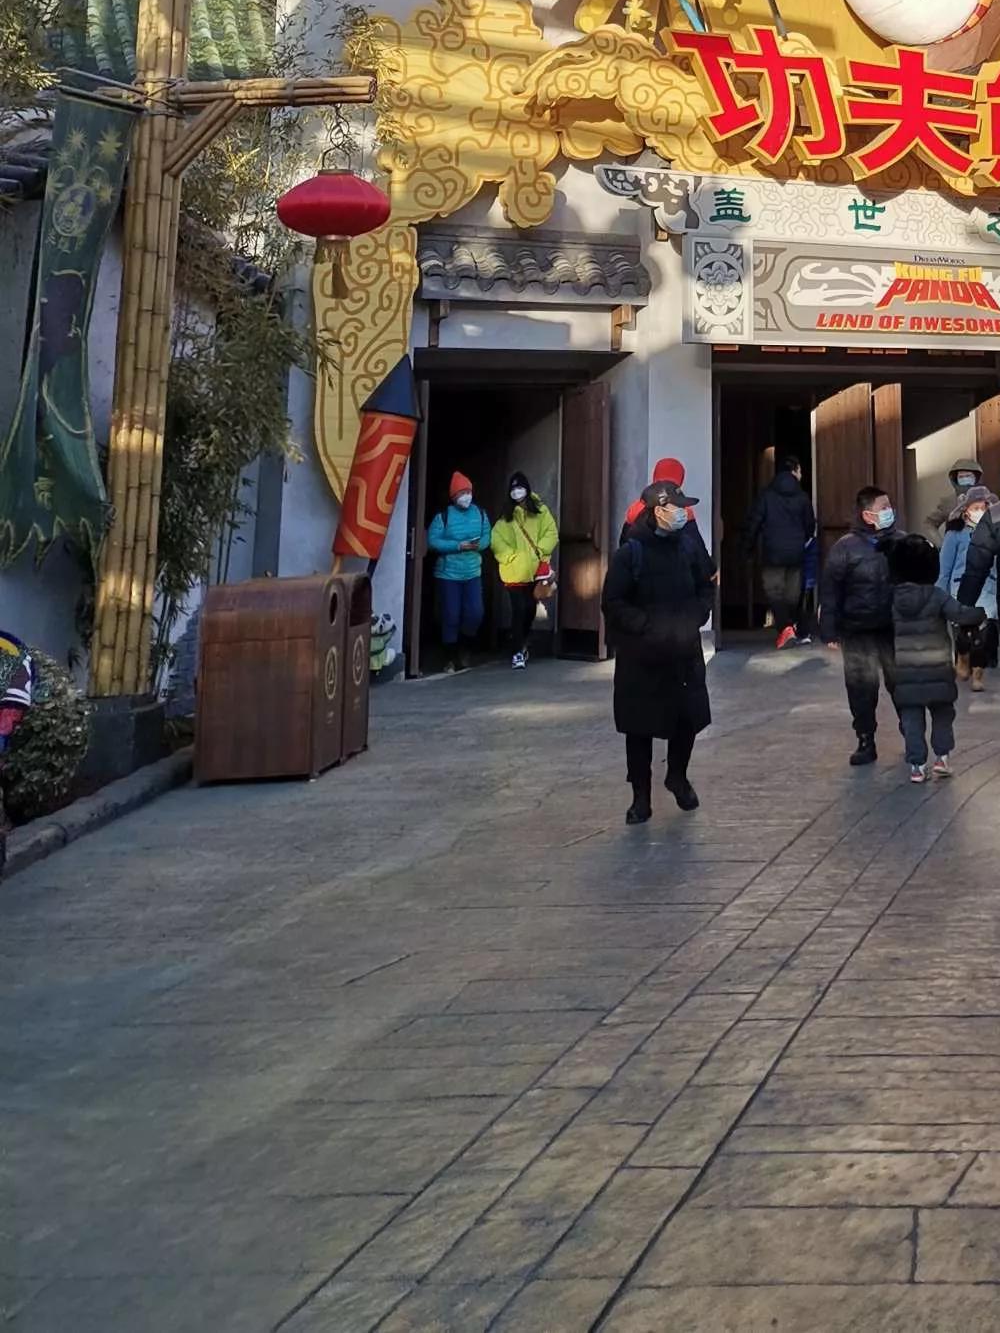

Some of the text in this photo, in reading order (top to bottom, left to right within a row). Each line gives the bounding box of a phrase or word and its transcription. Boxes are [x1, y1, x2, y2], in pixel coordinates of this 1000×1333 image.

[893, 262, 984, 282] KUNG FU
[815, 312, 873, 331] LAND
[877, 315, 905, 330] OF
